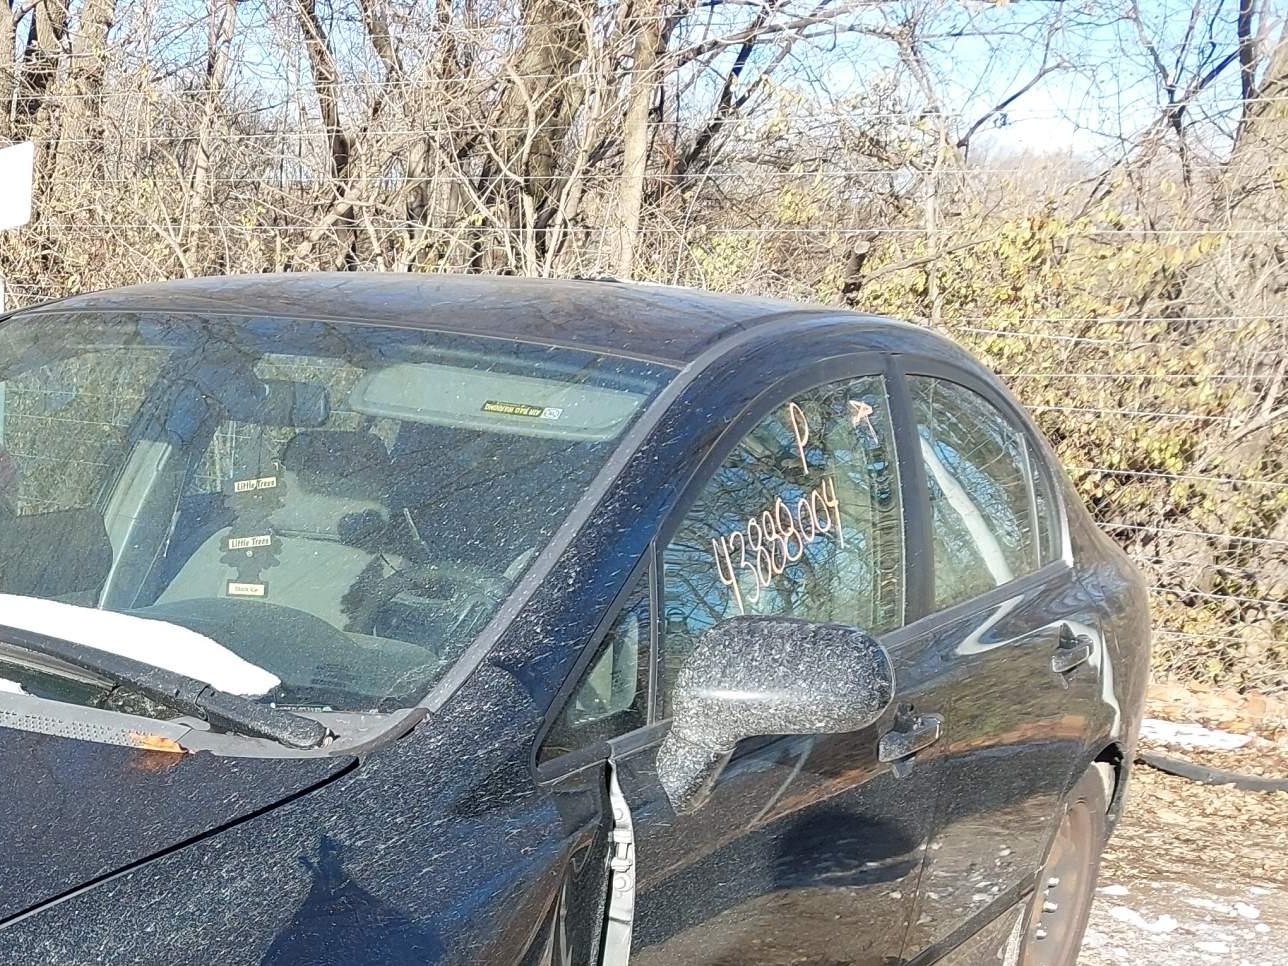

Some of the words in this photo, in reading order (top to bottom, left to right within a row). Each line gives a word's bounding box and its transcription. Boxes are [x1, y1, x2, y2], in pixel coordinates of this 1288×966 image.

[236, 480, 256, 491] Little
[257, 478, 275, 489] Trees
[231, 538, 250, 548] Little
[251, 536, 269, 546] Trees
[712, 477, 845, 615] 43888004
